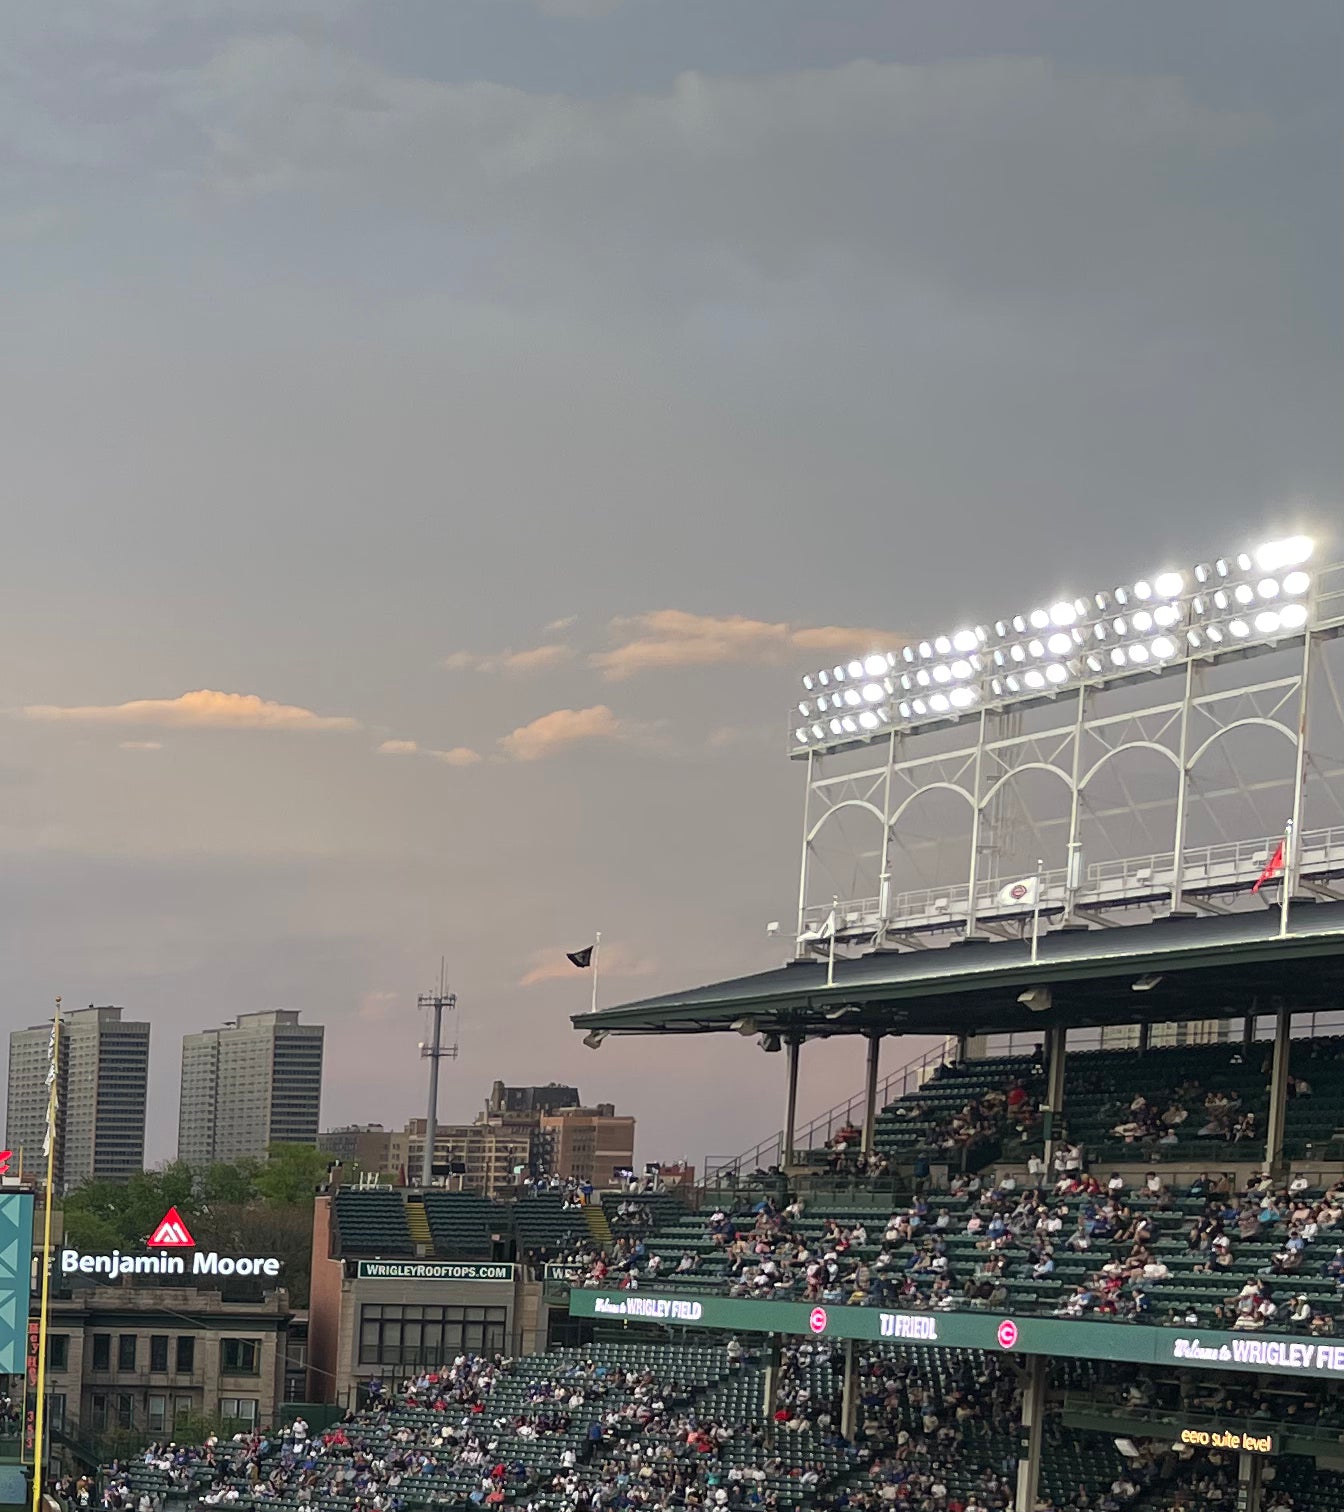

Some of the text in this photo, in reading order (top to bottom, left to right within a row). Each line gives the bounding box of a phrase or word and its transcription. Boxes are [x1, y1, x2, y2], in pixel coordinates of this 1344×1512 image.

[62, 1250, 280, 1278] Benjamin Moore
[366, 1264, 506, 1278] WRIGLEYROOFTOPS.COM
[627, 1298, 671, 1318] WRIGLEY
[672, 1301, 702, 1320] FIELD
[880, 1313, 938, 1340] TJ FRIEDL
[1232, 1339, 1315, 1368] WRIGLEY
[1181, 1429, 1272, 1452] eero suite level
